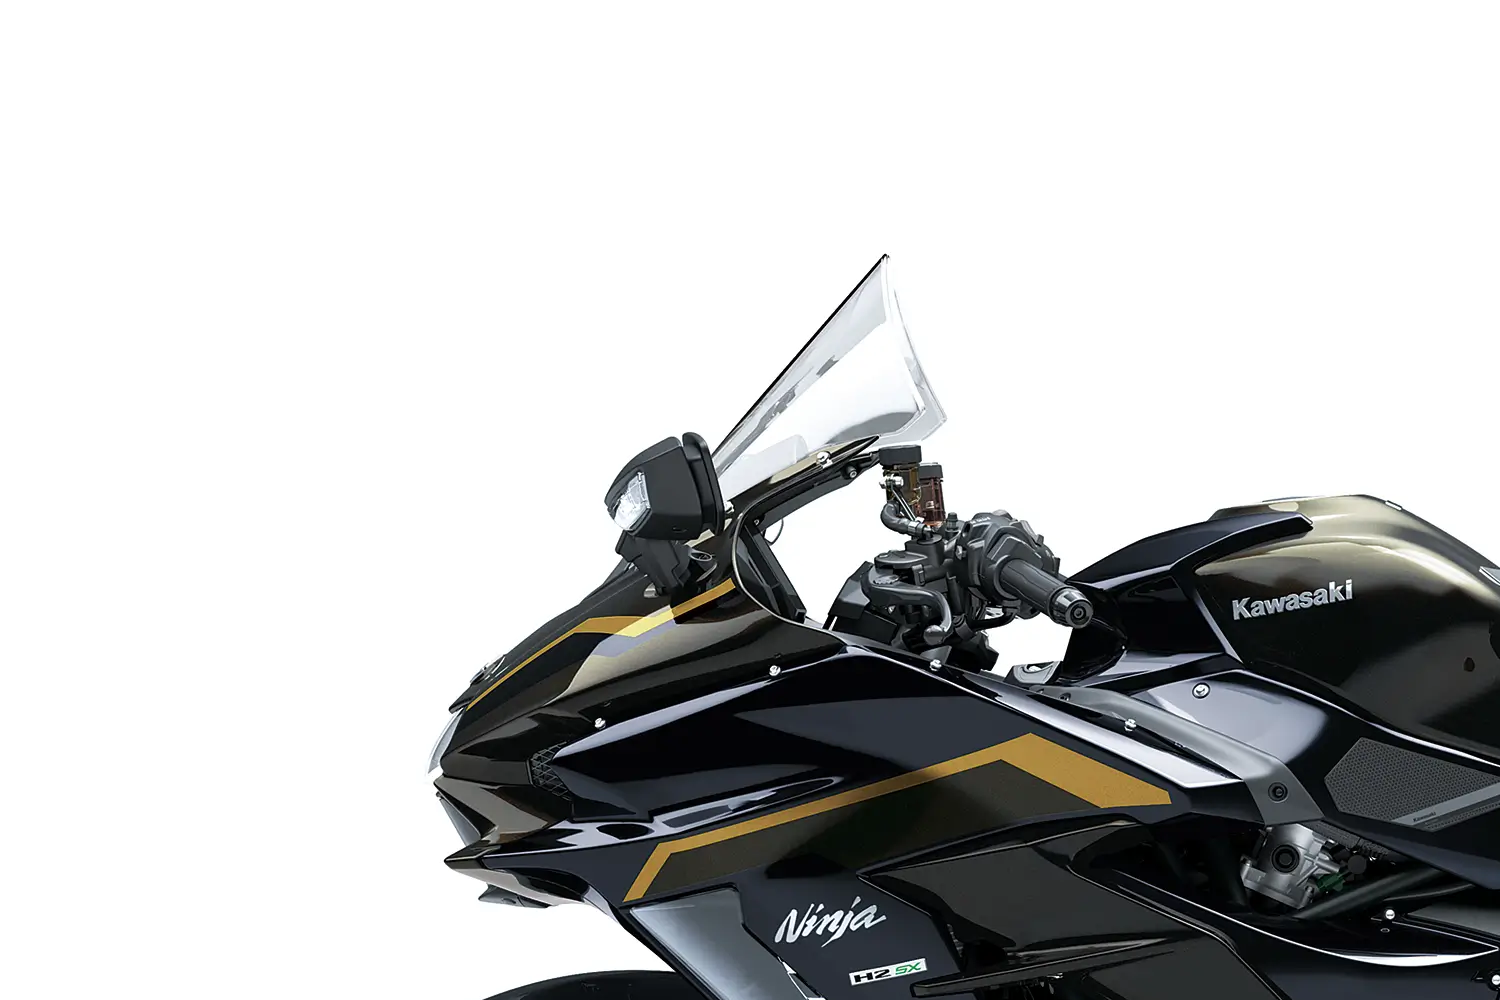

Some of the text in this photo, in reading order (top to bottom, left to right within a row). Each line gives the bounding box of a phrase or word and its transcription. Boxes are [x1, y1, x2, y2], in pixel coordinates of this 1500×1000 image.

[1232, 579, 1353, 621] Kawasaki
[774, 896, 887, 948] Ninja
[853, 962, 922, 983] H2 SX
